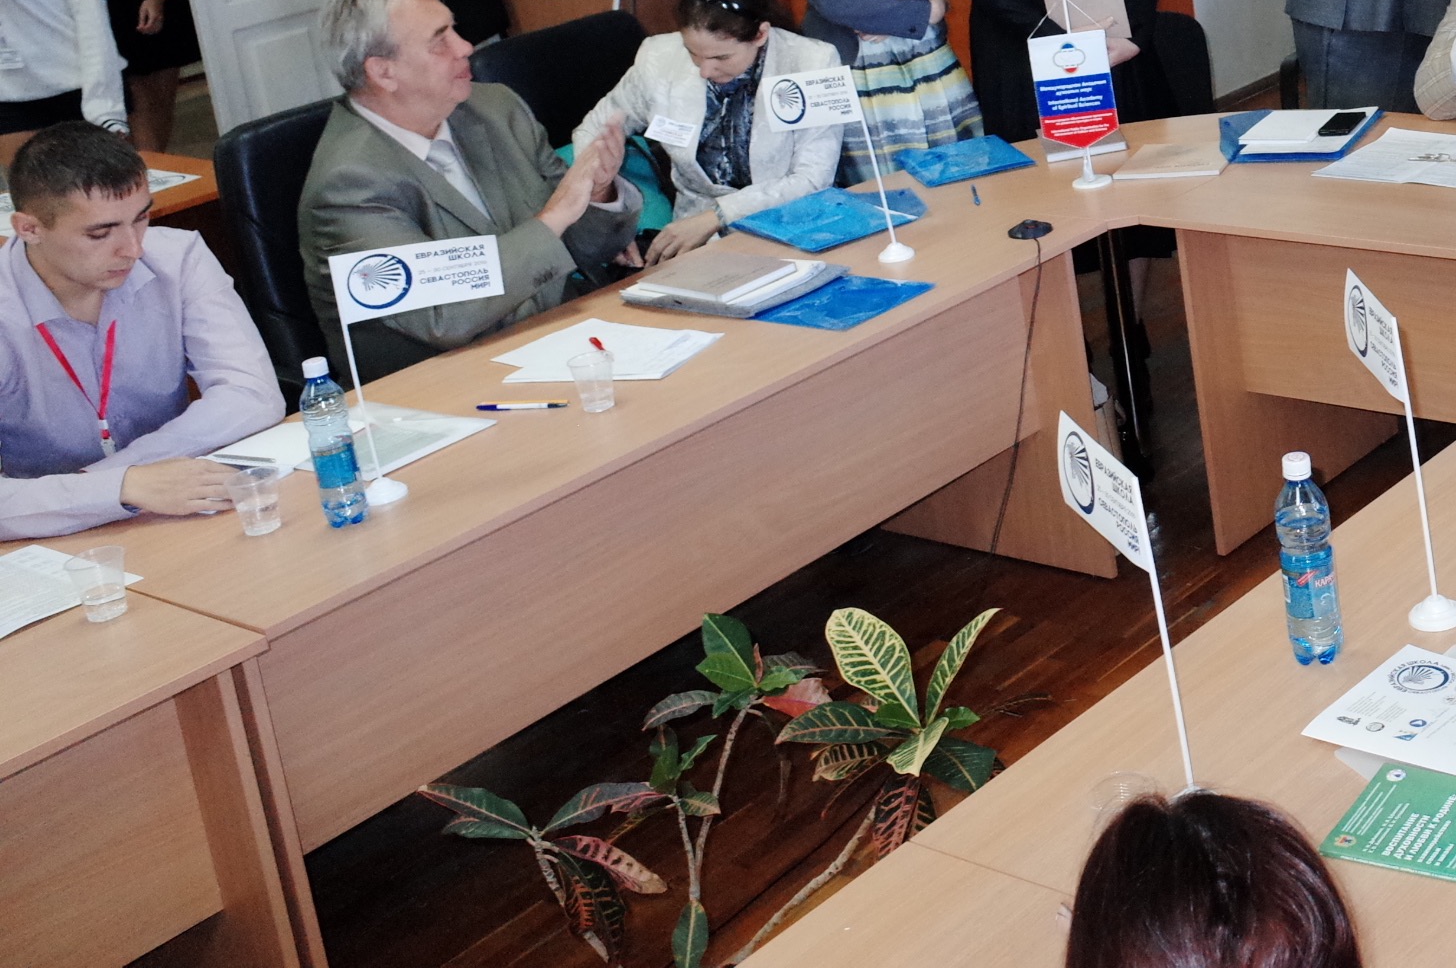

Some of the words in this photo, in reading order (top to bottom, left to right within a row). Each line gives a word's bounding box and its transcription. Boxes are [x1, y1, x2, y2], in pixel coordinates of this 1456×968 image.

[415, 244, 485, 260] ЕВРАЗИЙСКАЯ
[448, 251, 486, 261] ШКОЛА
[419, 268, 489, 284] СЕВАСТОПОЛЬ
[451, 275, 490, 286] РОССИЯ
[471, 281, 491, 290] МИР!
[1381, 812, 1420, 856] ВОСПИТАНИЕ
[1393, 814, 1431, 859] ДУХОВНОСТИ
[1408, 828, 1433, 854] ЛЮБВИ
